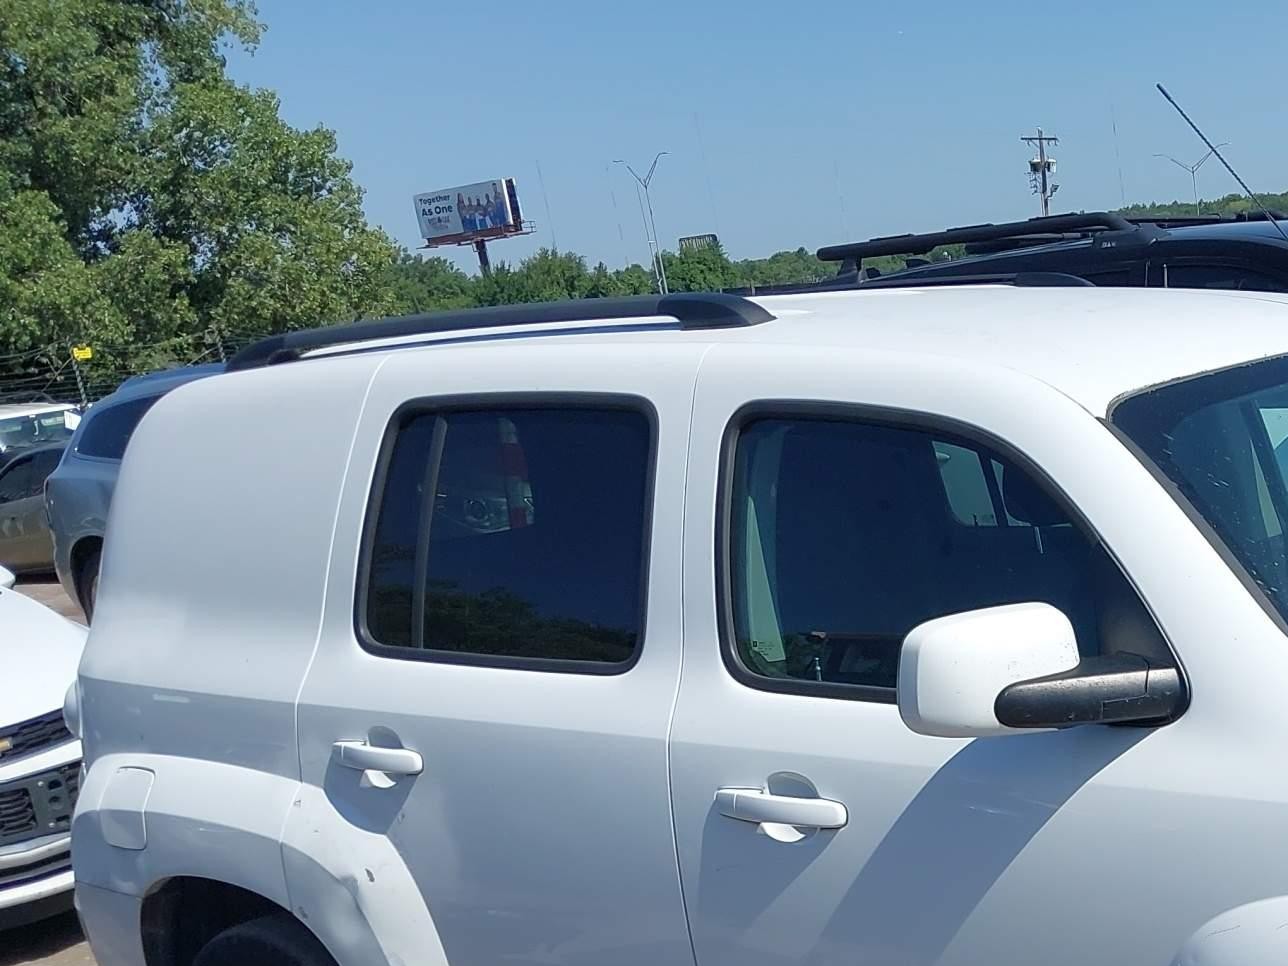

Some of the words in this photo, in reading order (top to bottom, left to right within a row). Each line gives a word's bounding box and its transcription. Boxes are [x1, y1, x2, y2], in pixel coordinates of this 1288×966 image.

[419, 195, 450, 206] Together
[422, 208, 433, 217] As
[434, 204, 453, 215] One
